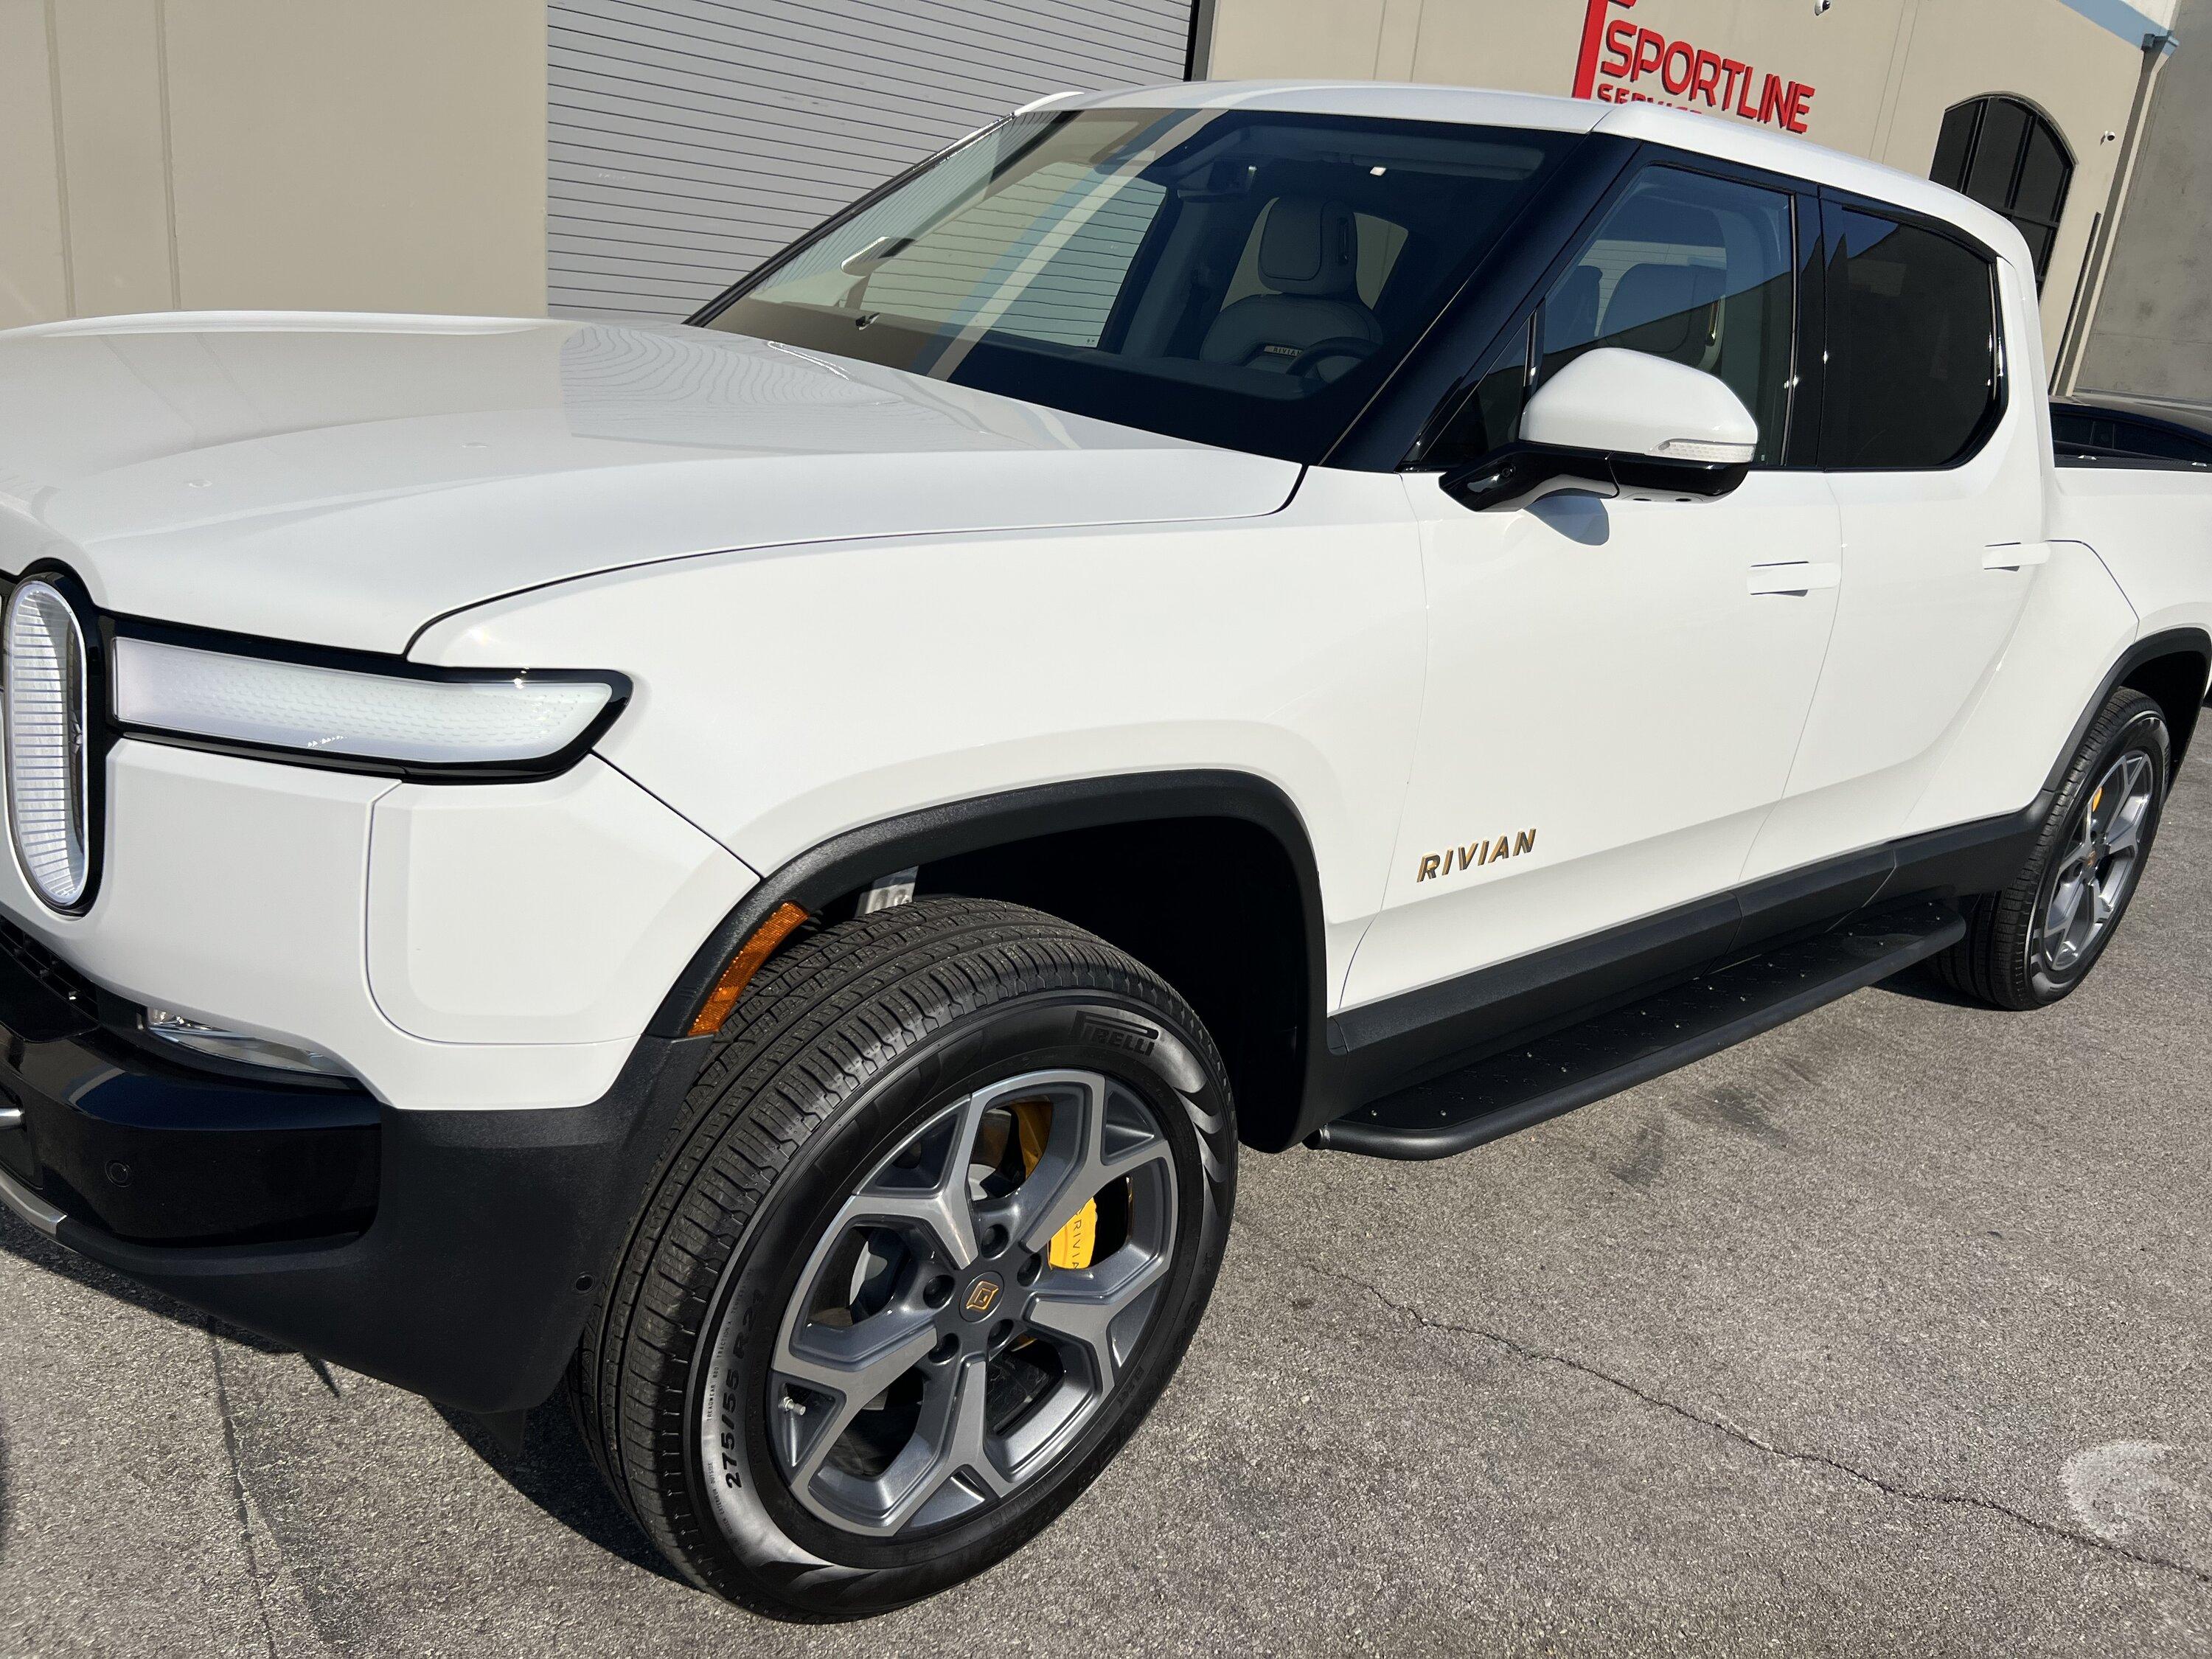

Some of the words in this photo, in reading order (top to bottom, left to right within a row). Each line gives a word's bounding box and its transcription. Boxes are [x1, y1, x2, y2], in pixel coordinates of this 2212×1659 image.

[1600, 20, 1815, 134] SPORTLINE
[1416, 827, 1537, 883] RIVIAN
[1071, 1010, 1160, 1057] PIRELLI
[1072, 1219, 1082, 1269] RIVIA
[721, 1368, 742, 1489] 275/55
